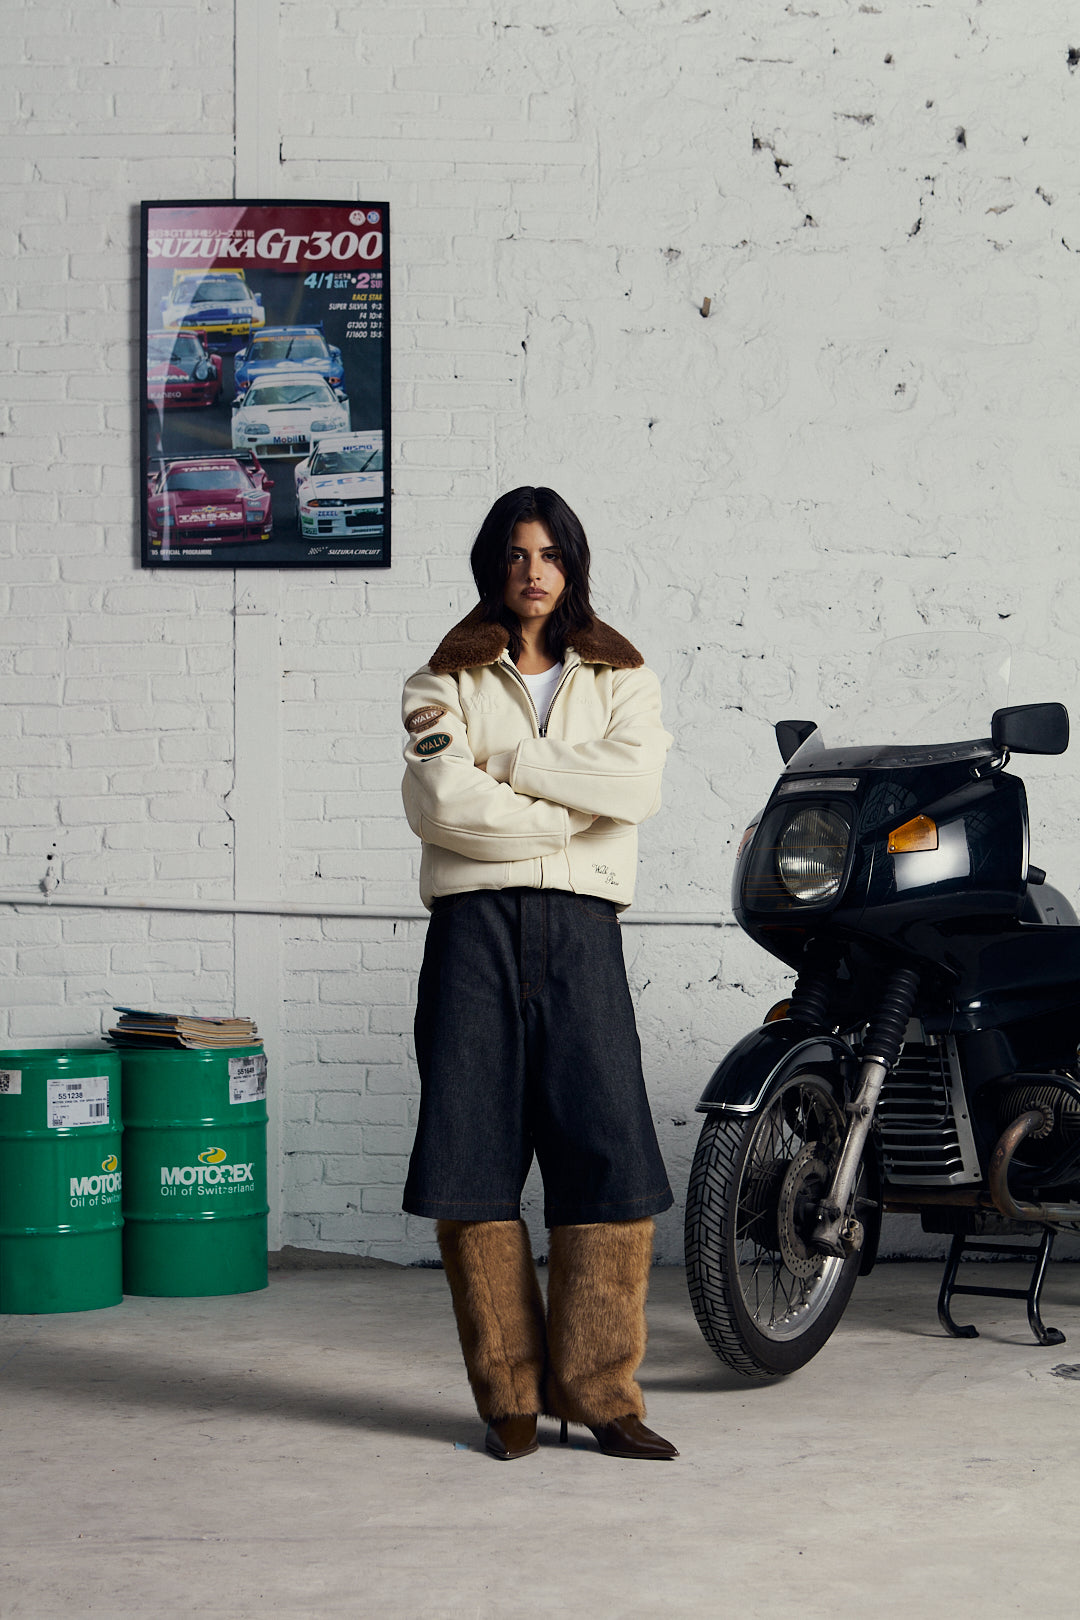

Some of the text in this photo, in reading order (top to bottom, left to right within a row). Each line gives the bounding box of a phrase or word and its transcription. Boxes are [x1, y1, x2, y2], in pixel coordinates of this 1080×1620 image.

[147, 229, 383, 263] SUZUKA GT300
[304, 272, 334, 289] 4/1
[333, 280, 349, 289] SAT
[370, 280, 383, 289] SU
[328, 303, 348, 311] SUPER
[348, 303, 368, 311] SILVIA
[346, 321, 368, 329] GT300
[273, 435, 298, 444] Mobil
[412, 710, 438, 725] WALK
[419, 735, 447, 752] WALK
[58, 1092, 83, 1100] 551238
[160, 1186, 177, 1196] Oil
[181, 1186, 193, 1196] of
[70, 1197, 85, 1208] Oil
[89, 1195, 99, 1207] of
